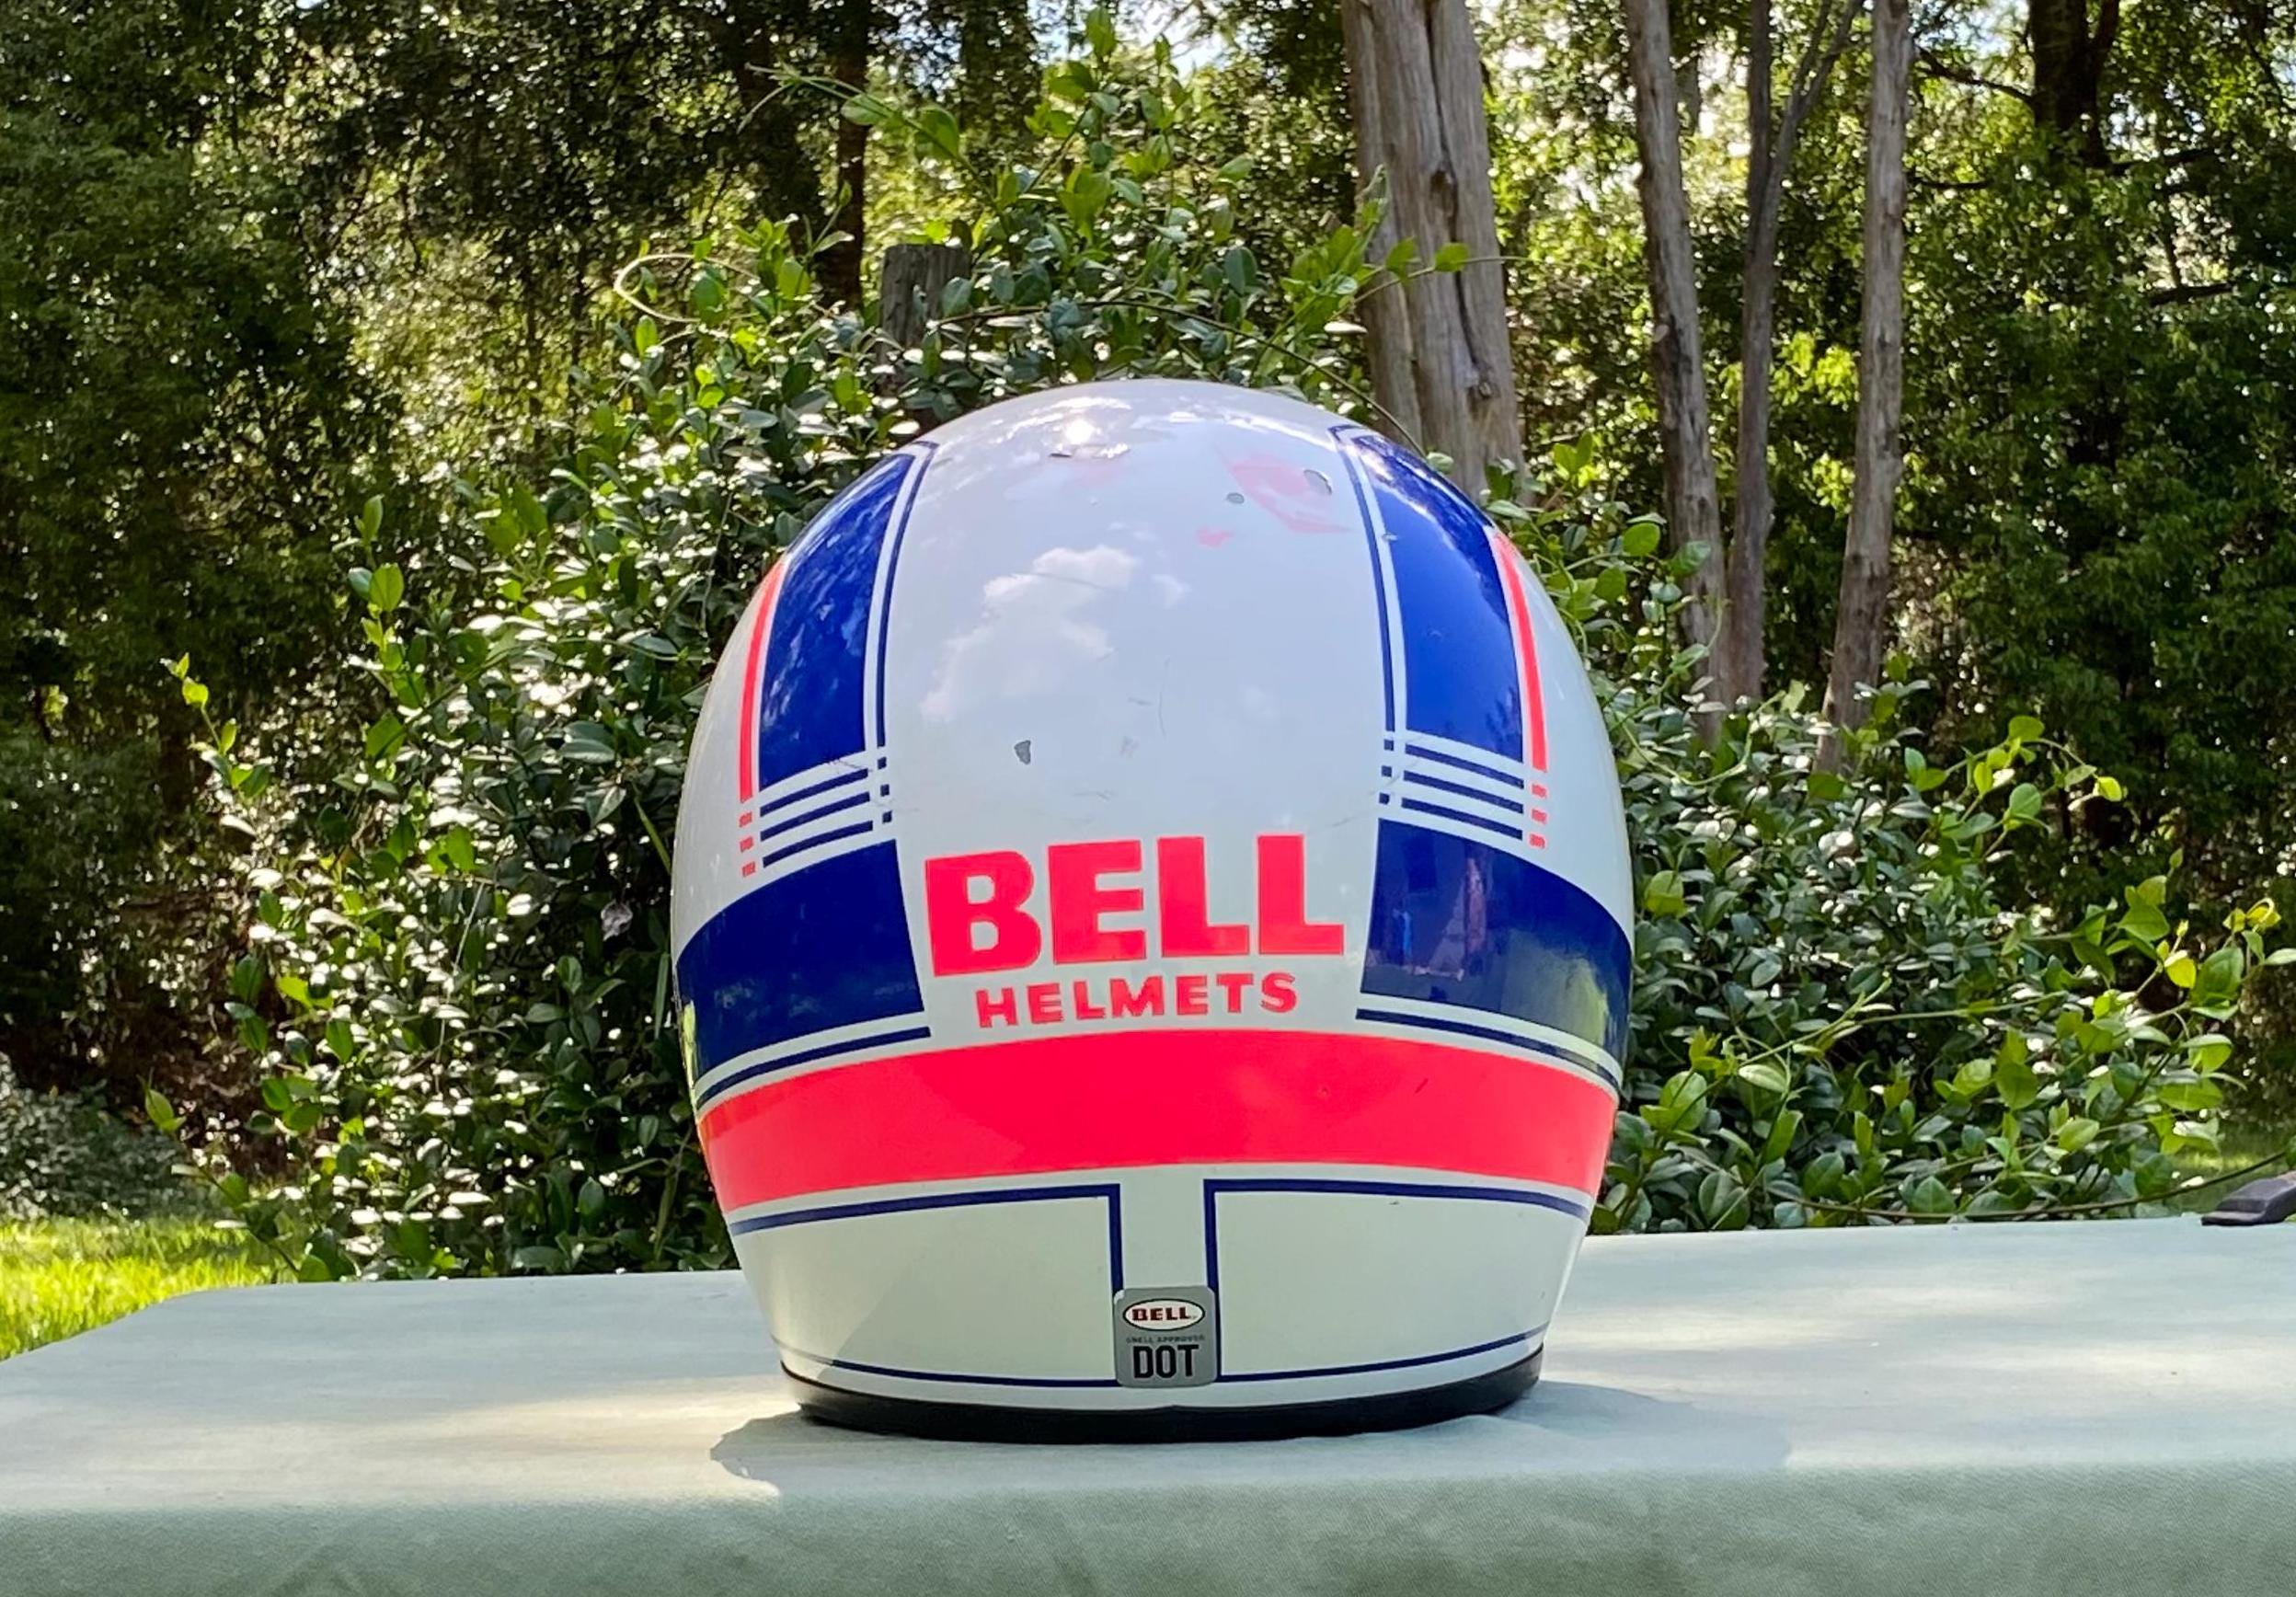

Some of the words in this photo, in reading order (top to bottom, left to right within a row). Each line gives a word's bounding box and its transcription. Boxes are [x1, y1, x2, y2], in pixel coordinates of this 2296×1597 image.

[924, 834, 1345, 977] BELL
[975, 971, 1298, 1028] HELMETS
[1132, 1307, 1190, 1321] BELL
[1133, 1344, 1200, 1378] DOT
